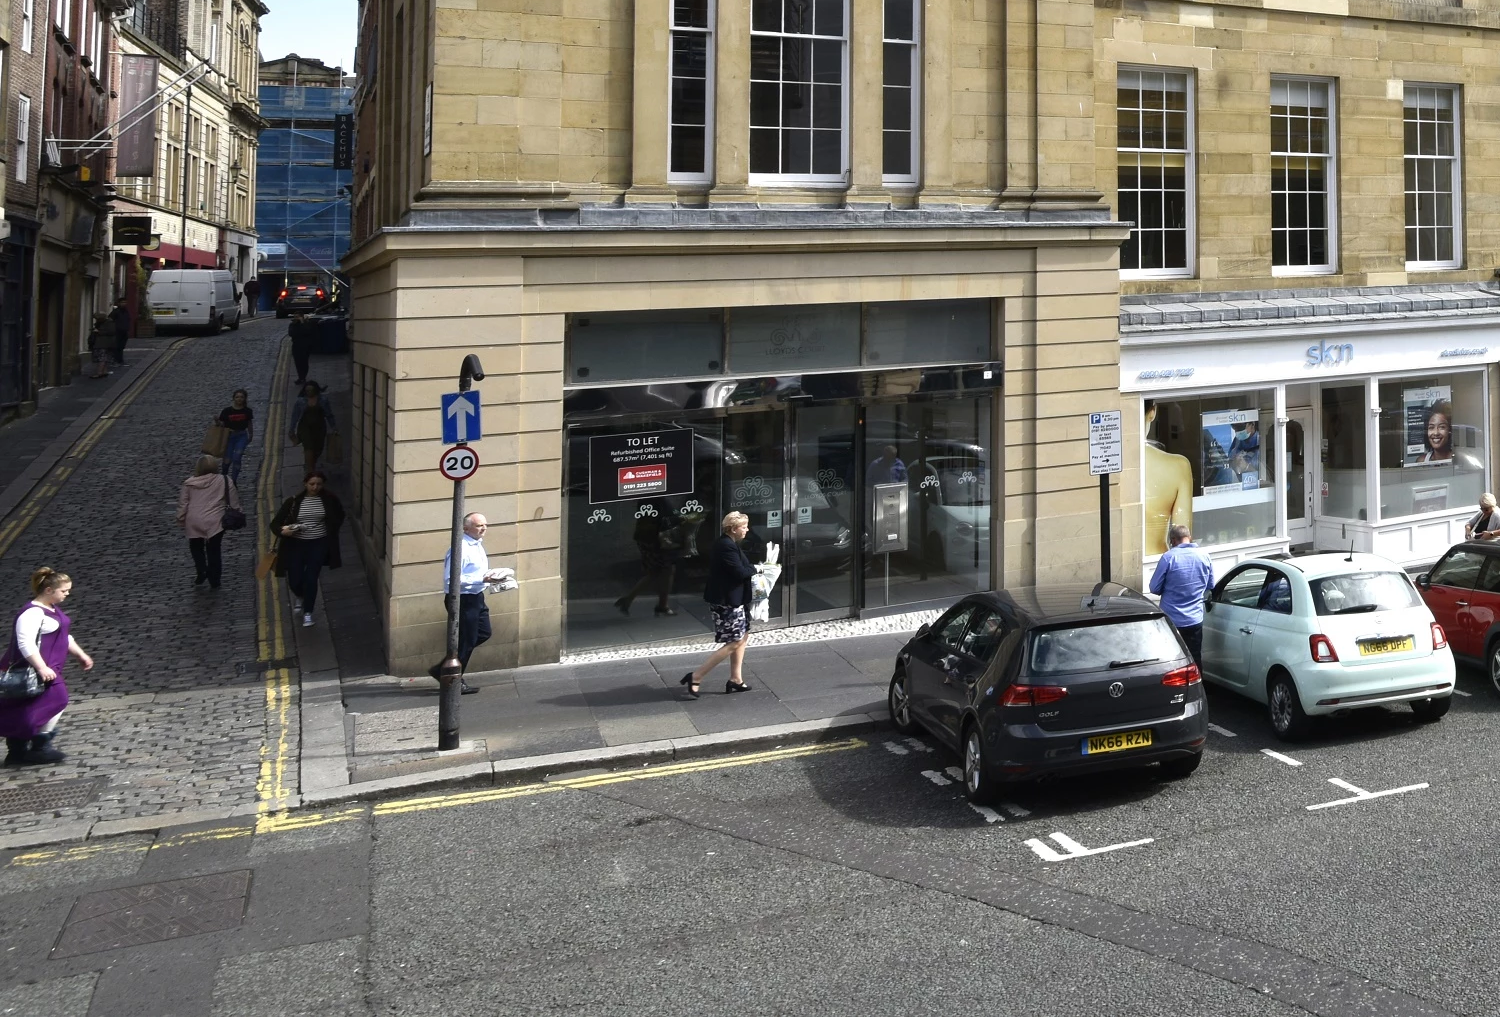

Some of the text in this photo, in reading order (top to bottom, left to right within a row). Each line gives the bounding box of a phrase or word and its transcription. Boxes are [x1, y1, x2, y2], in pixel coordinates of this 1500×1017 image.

[626, 436, 660, 447] TO LET
[610, 448, 644, 456] Refurbished
[446, 455, 474, 471] 20
[730, 497, 775, 508] LLOYDS COURT
[1363, 640, 1407, 653] NG66 DPF
[1090, 732, 1150, 751] NK66 RZN
